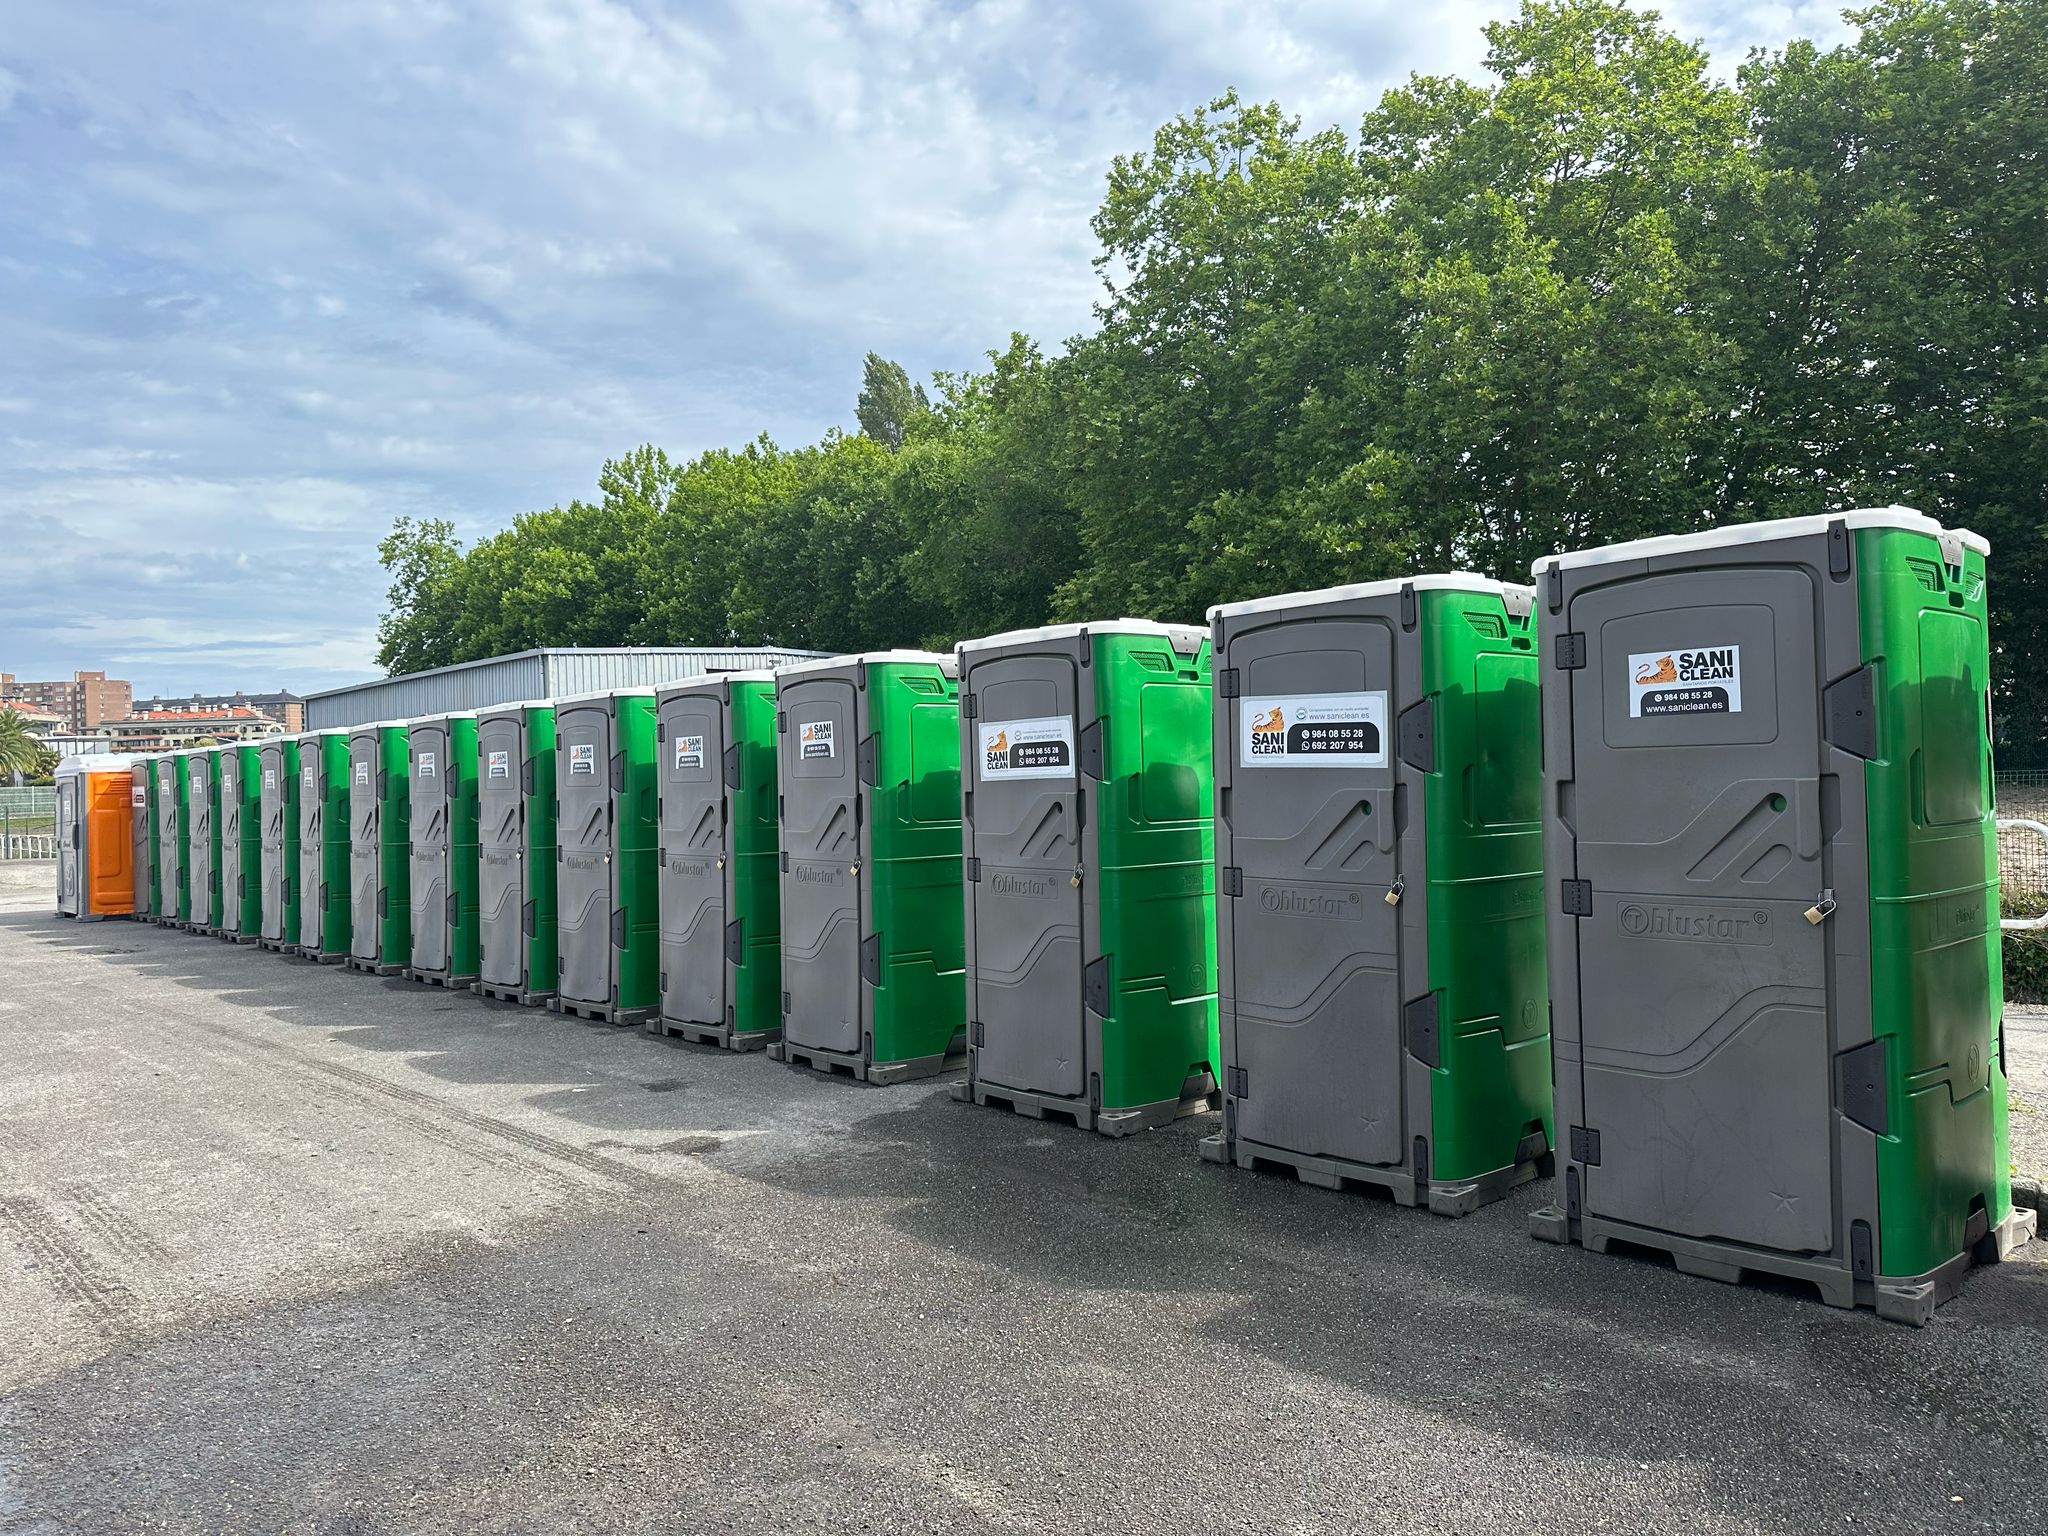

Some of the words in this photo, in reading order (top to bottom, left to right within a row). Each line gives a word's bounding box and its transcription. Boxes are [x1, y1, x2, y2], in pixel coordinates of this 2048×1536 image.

[1679, 650, 1733, 670] SANI
[1679, 667, 1734, 681] CLEAN
[1664, 693, 1678, 701] 984
[1680, 692, 1689, 700] 08
[1691, 691, 1701, 699] 55
[1702, 690, 1713, 699] 28
[1645, 702, 1723, 713] www.saniclean.es
[814, 723, 831, 733] SANI
[814, 732, 831, 740] CLEAN
[1311, 729, 1327, 738] 984
[1328, 729, 1339, 738] 08
[1341, 729, 1351, 738] 55
[1353, 729, 1364, 738] 28
[687, 737, 702, 745] SANI
[1251, 732, 1284, 745] SANI
[1251, 745, 1284, 754] CLEAN
[1311, 741, 1327, 749] 692
[1329, 741, 1345, 749] 207
[1348, 741, 1364, 749] 954
[986, 751, 1008, 762] SANI
[1037, 756, 1047, 764] 207
[987, 761, 1009, 770] CLEAN
